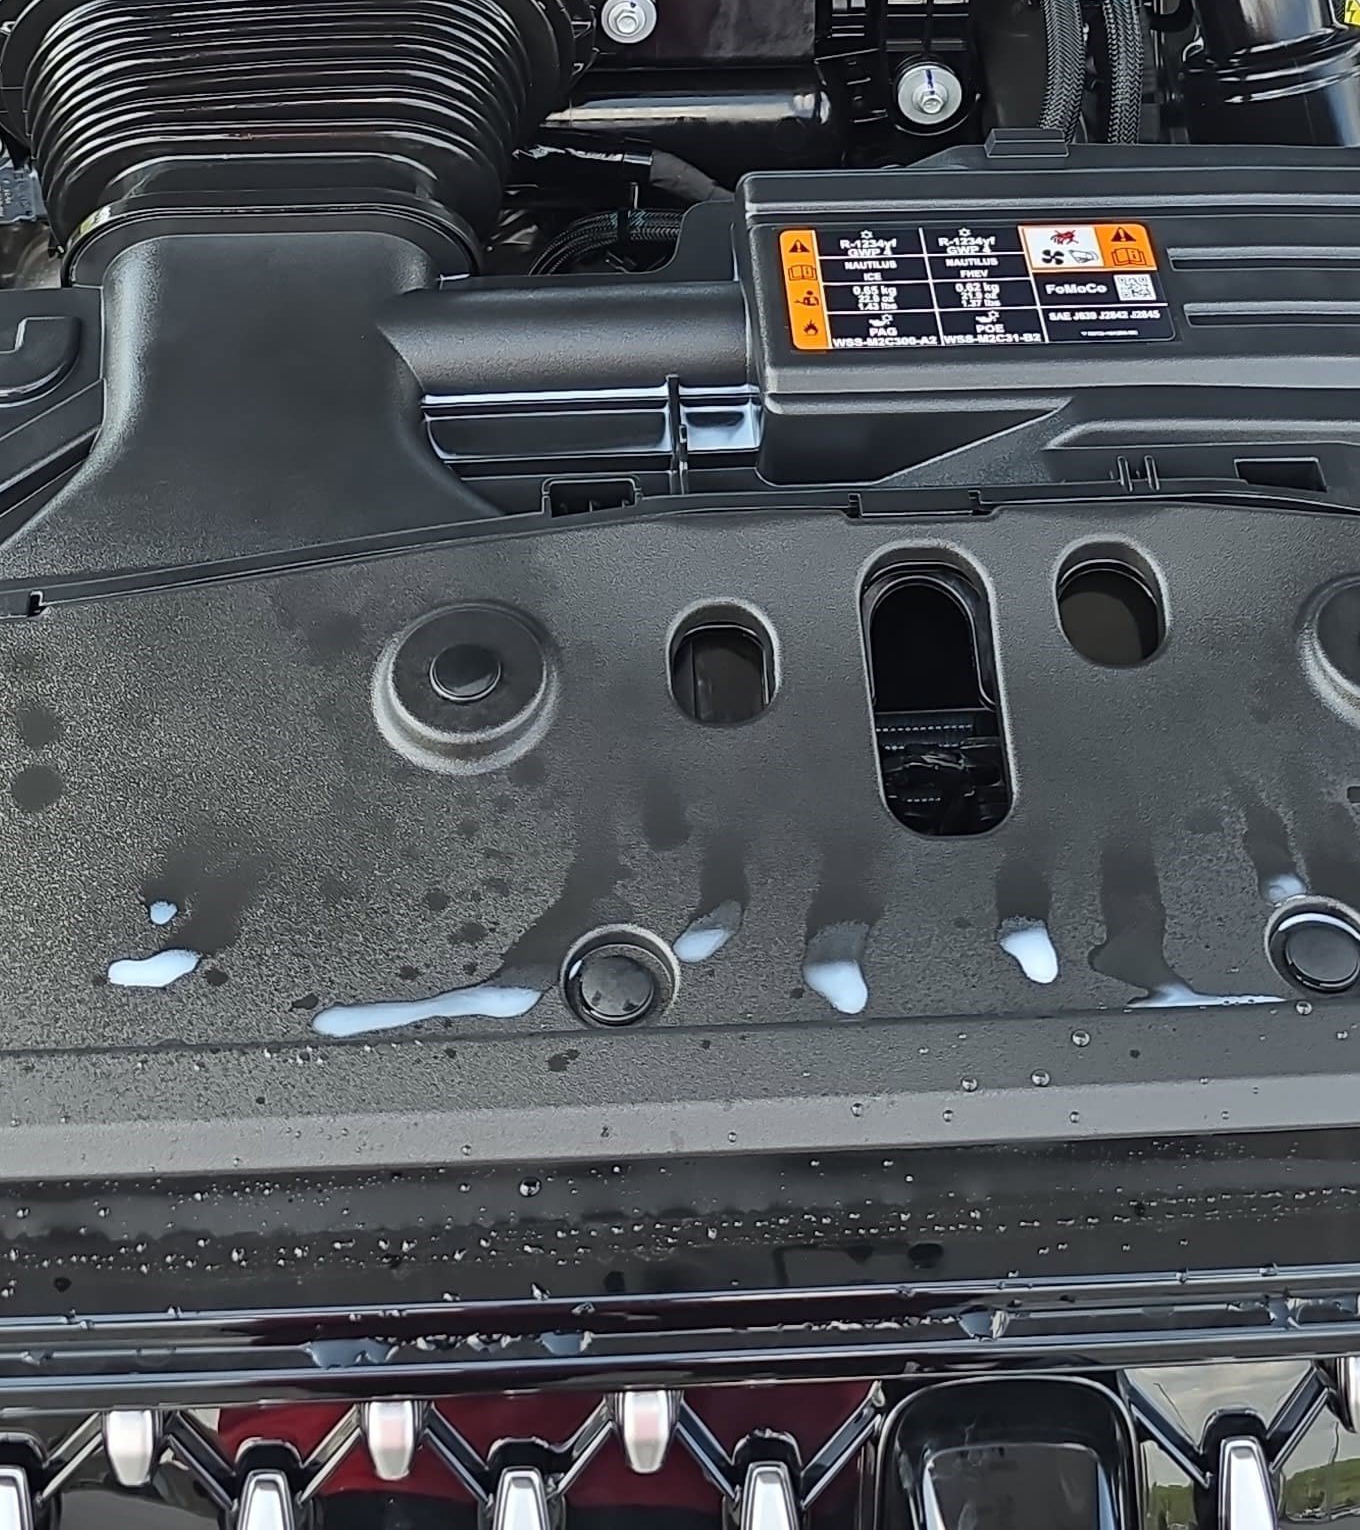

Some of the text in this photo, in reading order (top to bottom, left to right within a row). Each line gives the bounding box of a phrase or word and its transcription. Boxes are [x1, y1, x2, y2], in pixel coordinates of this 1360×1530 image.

[840, 238, 897, 251] R-1234yf
[939, 236, 995, 249] R-1234yf
[848, 248, 880, 256] GWP
[947, 246, 978, 254] GWP
[845, 259, 897, 269] NAUTILUS
[946, 257, 998, 267] NAUTILUS
[864, 273, 882, 281] ICE
[960, 269, 988, 278] FHEV
[853, 286, 897, 297] 0.65 kg
[955, 283, 999, 295] 0.62 kg
[1045, 283, 1107, 294] FoMoCo
[1048, 312, 1072, 320] SAE
[869, 327, 897, 336] PAG
[975, 324, 1004, 333] POE
[833, 336, 937, 348] WSS-M2C300-A2
[943, 333, 1041, 344] WSS-M2C31-B2
